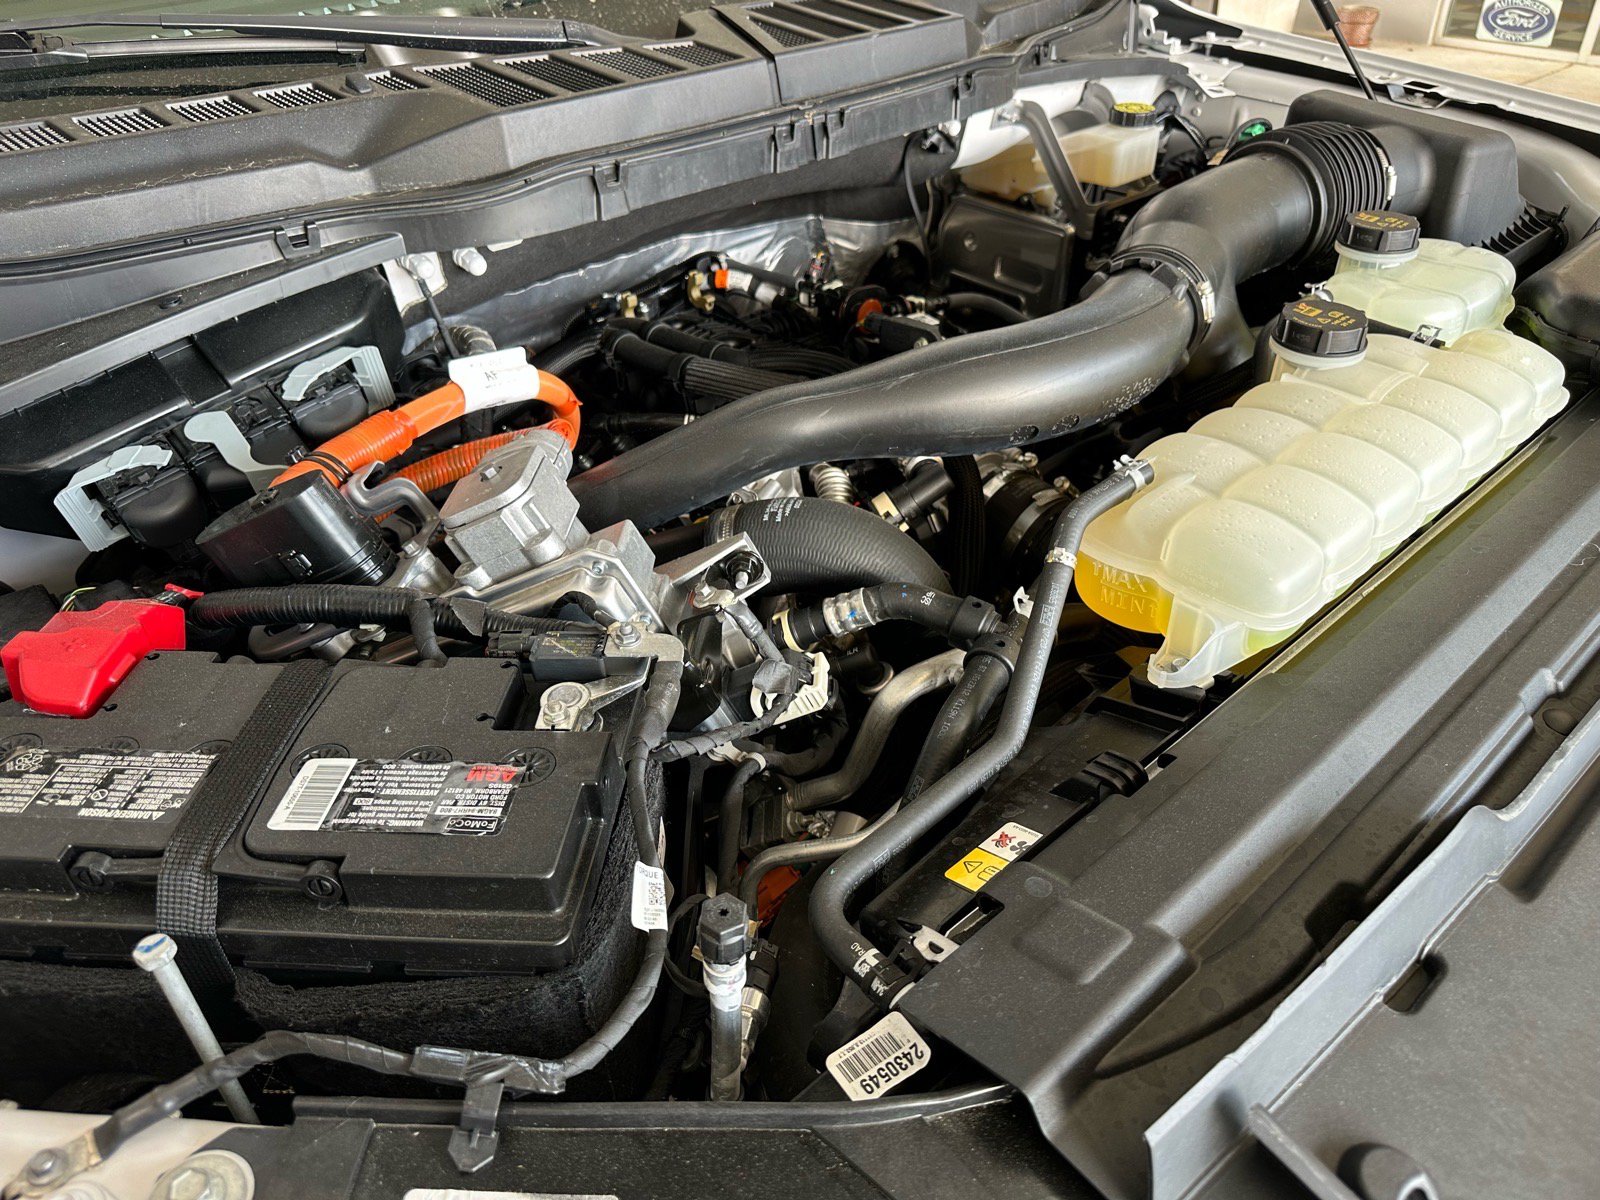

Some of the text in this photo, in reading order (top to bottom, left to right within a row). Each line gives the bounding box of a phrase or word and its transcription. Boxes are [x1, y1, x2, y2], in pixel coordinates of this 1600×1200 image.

[1496, 9, 1541, 28] Ford
[1493, 29, 1533, 42] SERVICE
[1101, 586, 1145, 614] MIN
[465, 770, 516, 782] AGM
[380, 788, 440, 796] AVERTISSEMENT
[78, 808, 152, 820] DANGER/POISON
[386, 819, 424, 827] WARNING:
[449, 820, 495, 829] FoMoCo
[850, 942, 866, 958] RAD
[860, 1042, 924, 1094] 2430549
